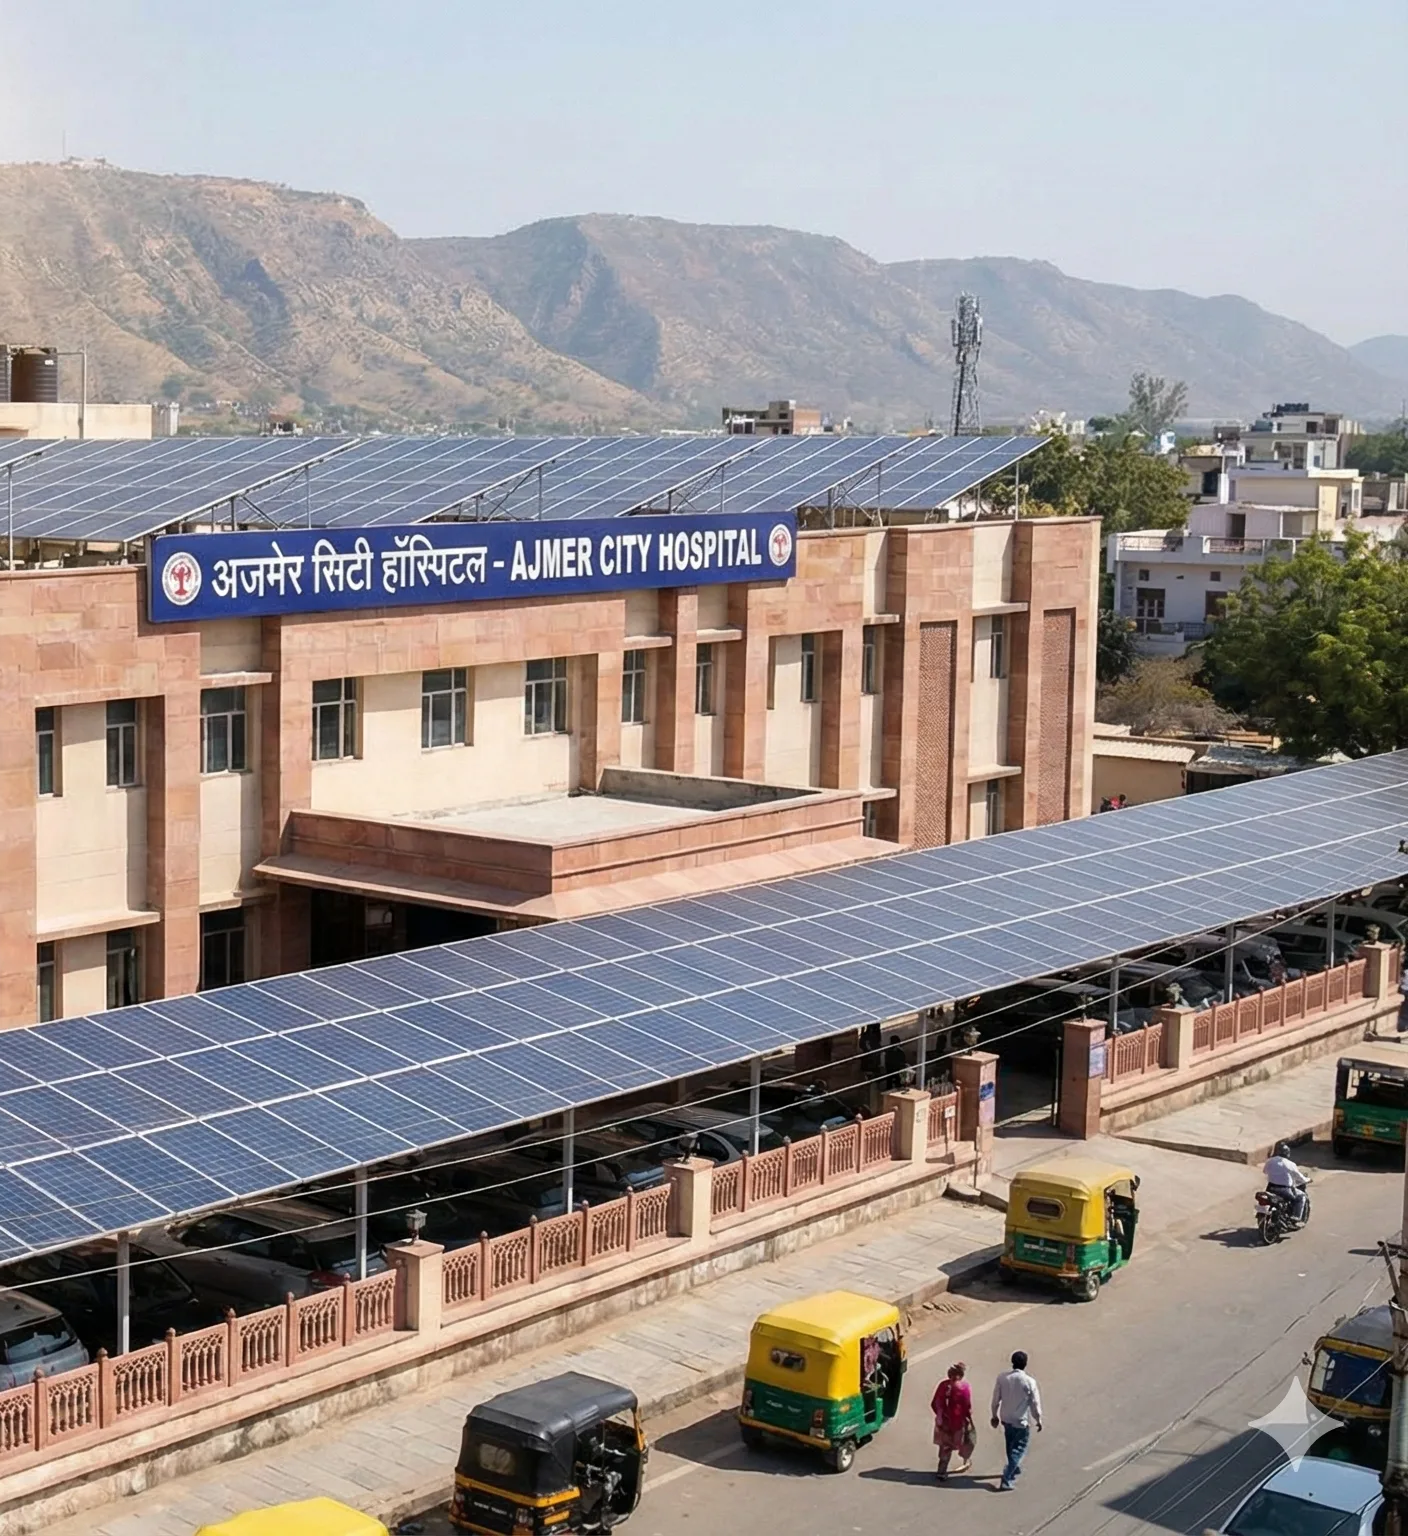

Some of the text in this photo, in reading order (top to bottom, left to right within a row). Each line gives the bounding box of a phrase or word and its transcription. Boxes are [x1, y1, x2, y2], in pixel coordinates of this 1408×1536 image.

[211, 541, 304, 598] अजमेर
[311, 537, 373, 593] सिटी
[381, 535, 487, 593] हॉस्पिटल
[510, 536, 593, 581] AJMER
[599, 533, 652, 576] CITY
[659, 529, 762, 571] HOSPITAL
